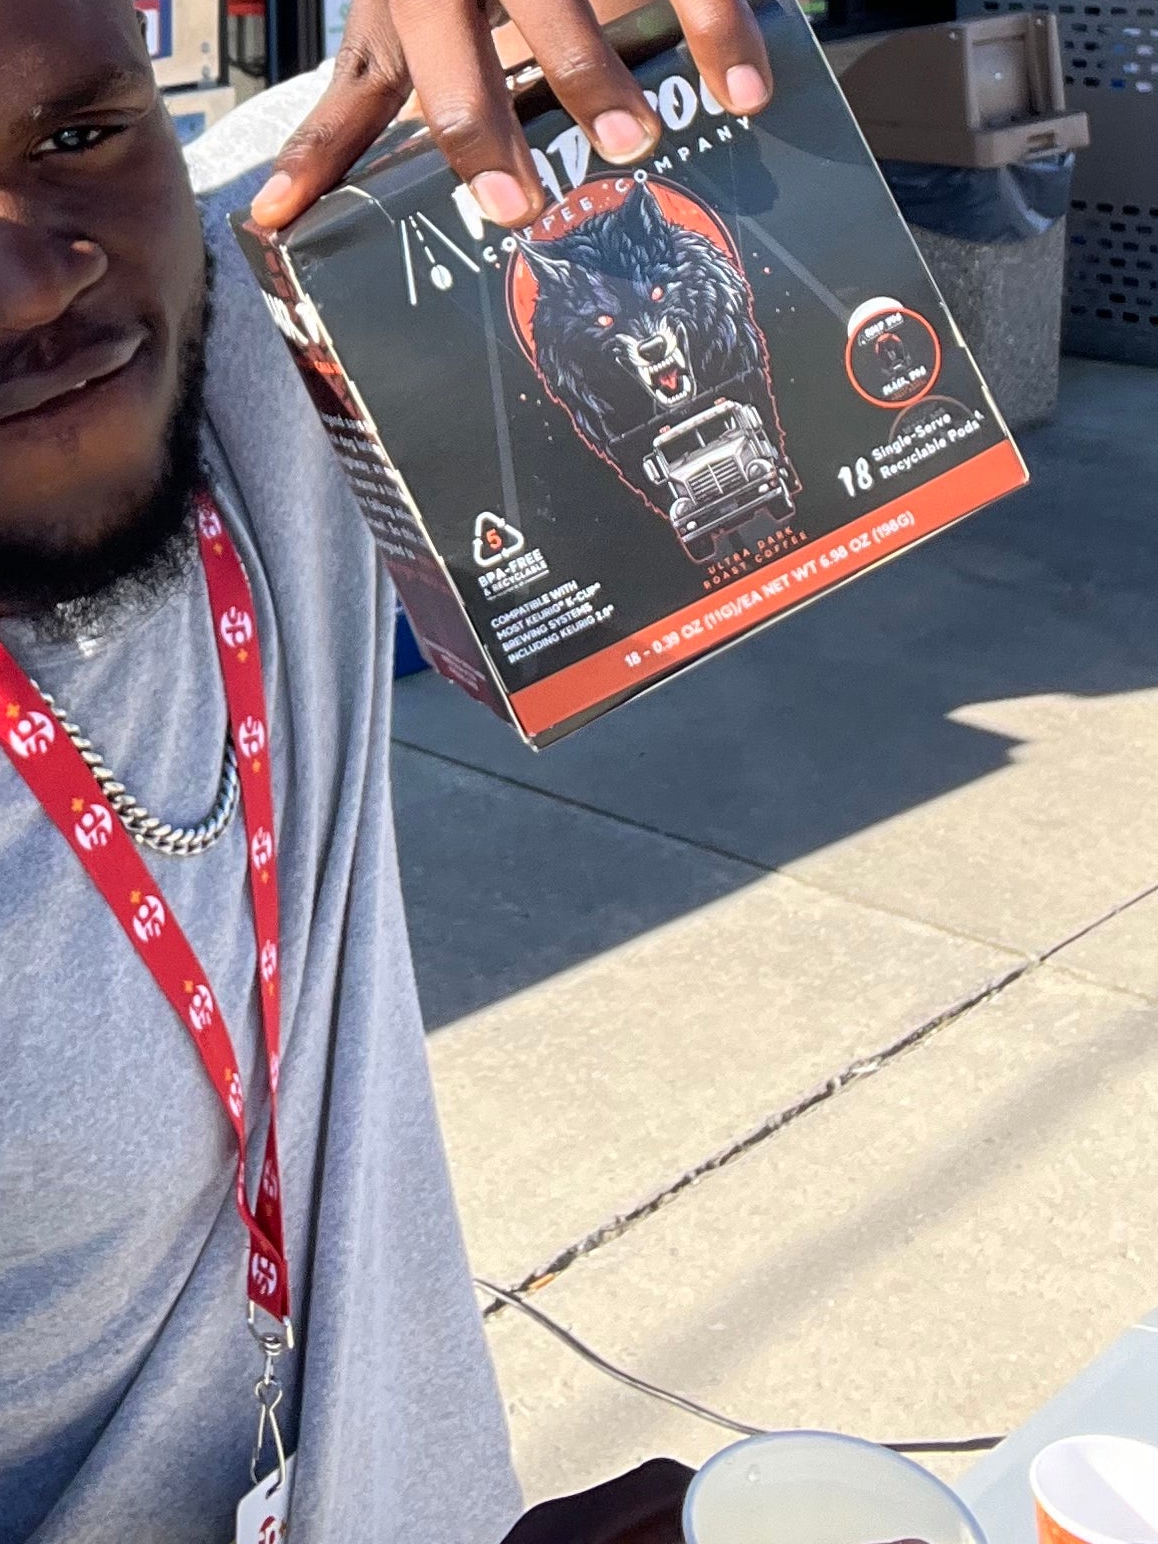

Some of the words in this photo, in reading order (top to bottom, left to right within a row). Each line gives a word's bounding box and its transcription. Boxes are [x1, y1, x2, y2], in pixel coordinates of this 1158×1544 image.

[483, 197, 594, 264] COFFEE
[614, 116, 753, 194] COMPANY
[872, 414, 951, 461] Single-Serve
[880, 437, 946, 478] Recyclable
[839, 457, 873, 496] 18
[486, 529, 503, 549] 5
[704, 562, 747, 589] ROAST
[755, 530, 809, 564] COFFEE
[708, 550, 751, 574] ULTRA
[757, 527, 793, 550] DARK
[478, 549, 543, 587] BPA-FREE
[492, 560, 548, 591] RECYCLABLE
[492, 596, 550, 628] COMPATIBLE
[550, 580, 578, 601] WITH
[625, 650, 641, 666] 18
[653, 632, 680, 653] 0.39
[681, 621, 704, 639] OZ
[762, 574, 790, 598] NET
[792, 560, 818, 582] WT
[819, 545, 848, 568] 6.98
[849, 533, 871, 552] OZ
[497, 620, 524, 640] MOST
[503, 626, 548, 651] BREWING
[548, 602, 593, 629] SYSTEMS
[508, 634, 559, 663] INCLUDING
[560, 614, 595, 637] KEURIG
